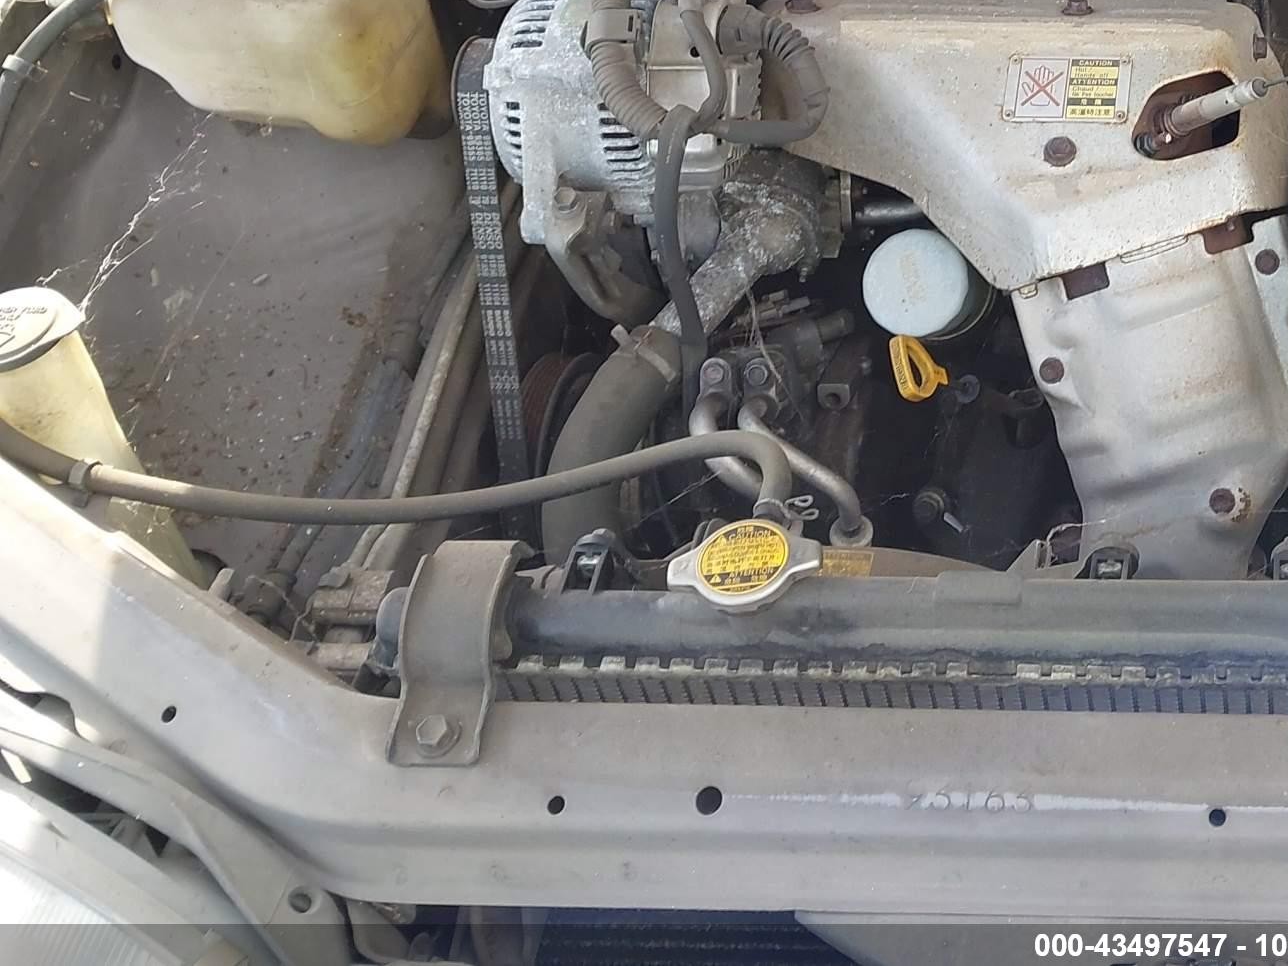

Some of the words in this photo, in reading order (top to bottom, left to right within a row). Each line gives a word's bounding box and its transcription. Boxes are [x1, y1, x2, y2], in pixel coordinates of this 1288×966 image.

[462, 91, 472, 131] TOYOTA
[471, 91, 481, 131] TOYOTA
[480, 91, 489, 131] TOYOTA
[728, 529, 771, 542] CAUTION
[728, 567, 774, 578] ATTENTION
